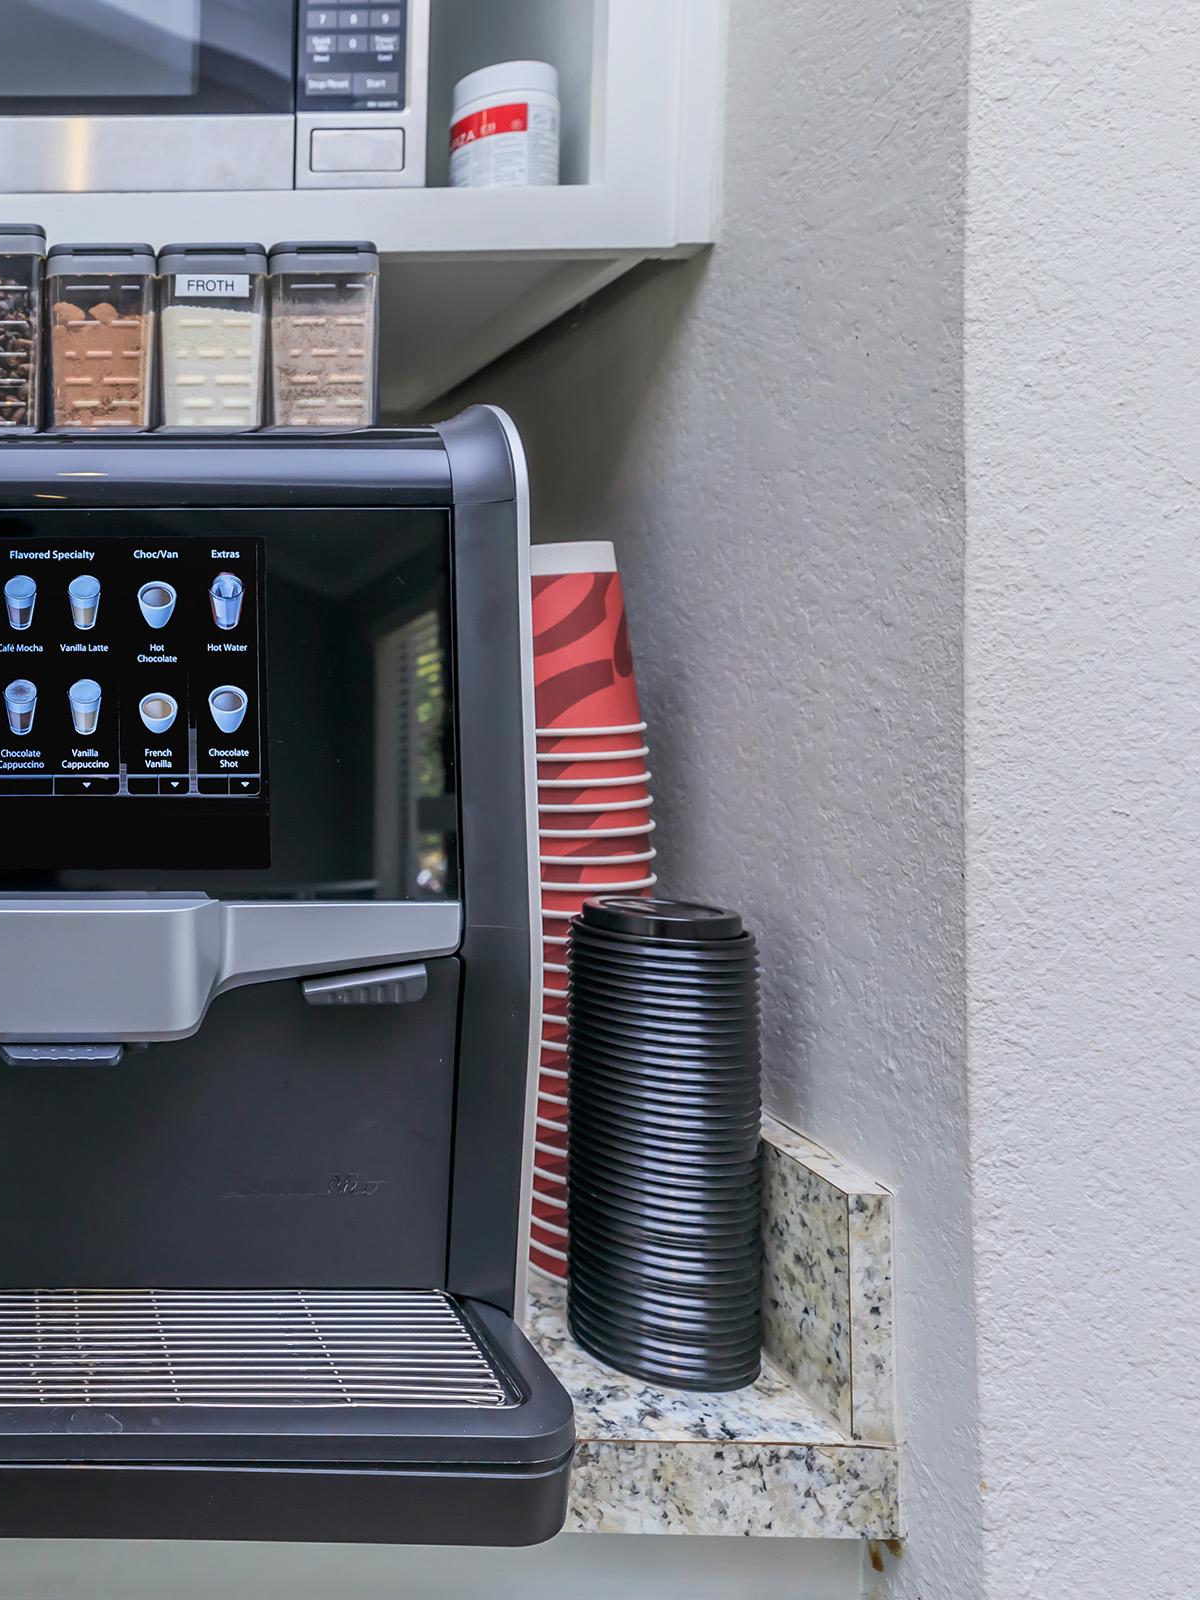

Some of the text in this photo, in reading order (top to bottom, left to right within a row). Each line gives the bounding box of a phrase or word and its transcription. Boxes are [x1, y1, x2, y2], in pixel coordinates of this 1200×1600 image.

[320, 14, 326, 24] 7
[381, 13, 389, 24] 9
[187, 280, 234, 291] FROTH
[9, 549, 96, 560] Flavored Specialty
[133, 549, 179, 559] Choc/Van
[211, 549, 241, 558] Extras
[15, 644, 44, 652] Mocha
[59, 644, 109, 652] Vanilla Latte
[149, 644, 165, 652] Hot
[207, 644, 248, 652] Hot Water
[136, 654, 178, 662] Chocolate
[0, 749, 42, 757] Chocolate
[71, 749, 99, 757] Vanilla
[144, 748, 173, 757] French
[208, 748, 250, 756] Chocolate
[61, 759, 110, 770] Cappuccino
[144, 759, 173, 768] Vanilla
[219, 759, 239, 768] Shot
